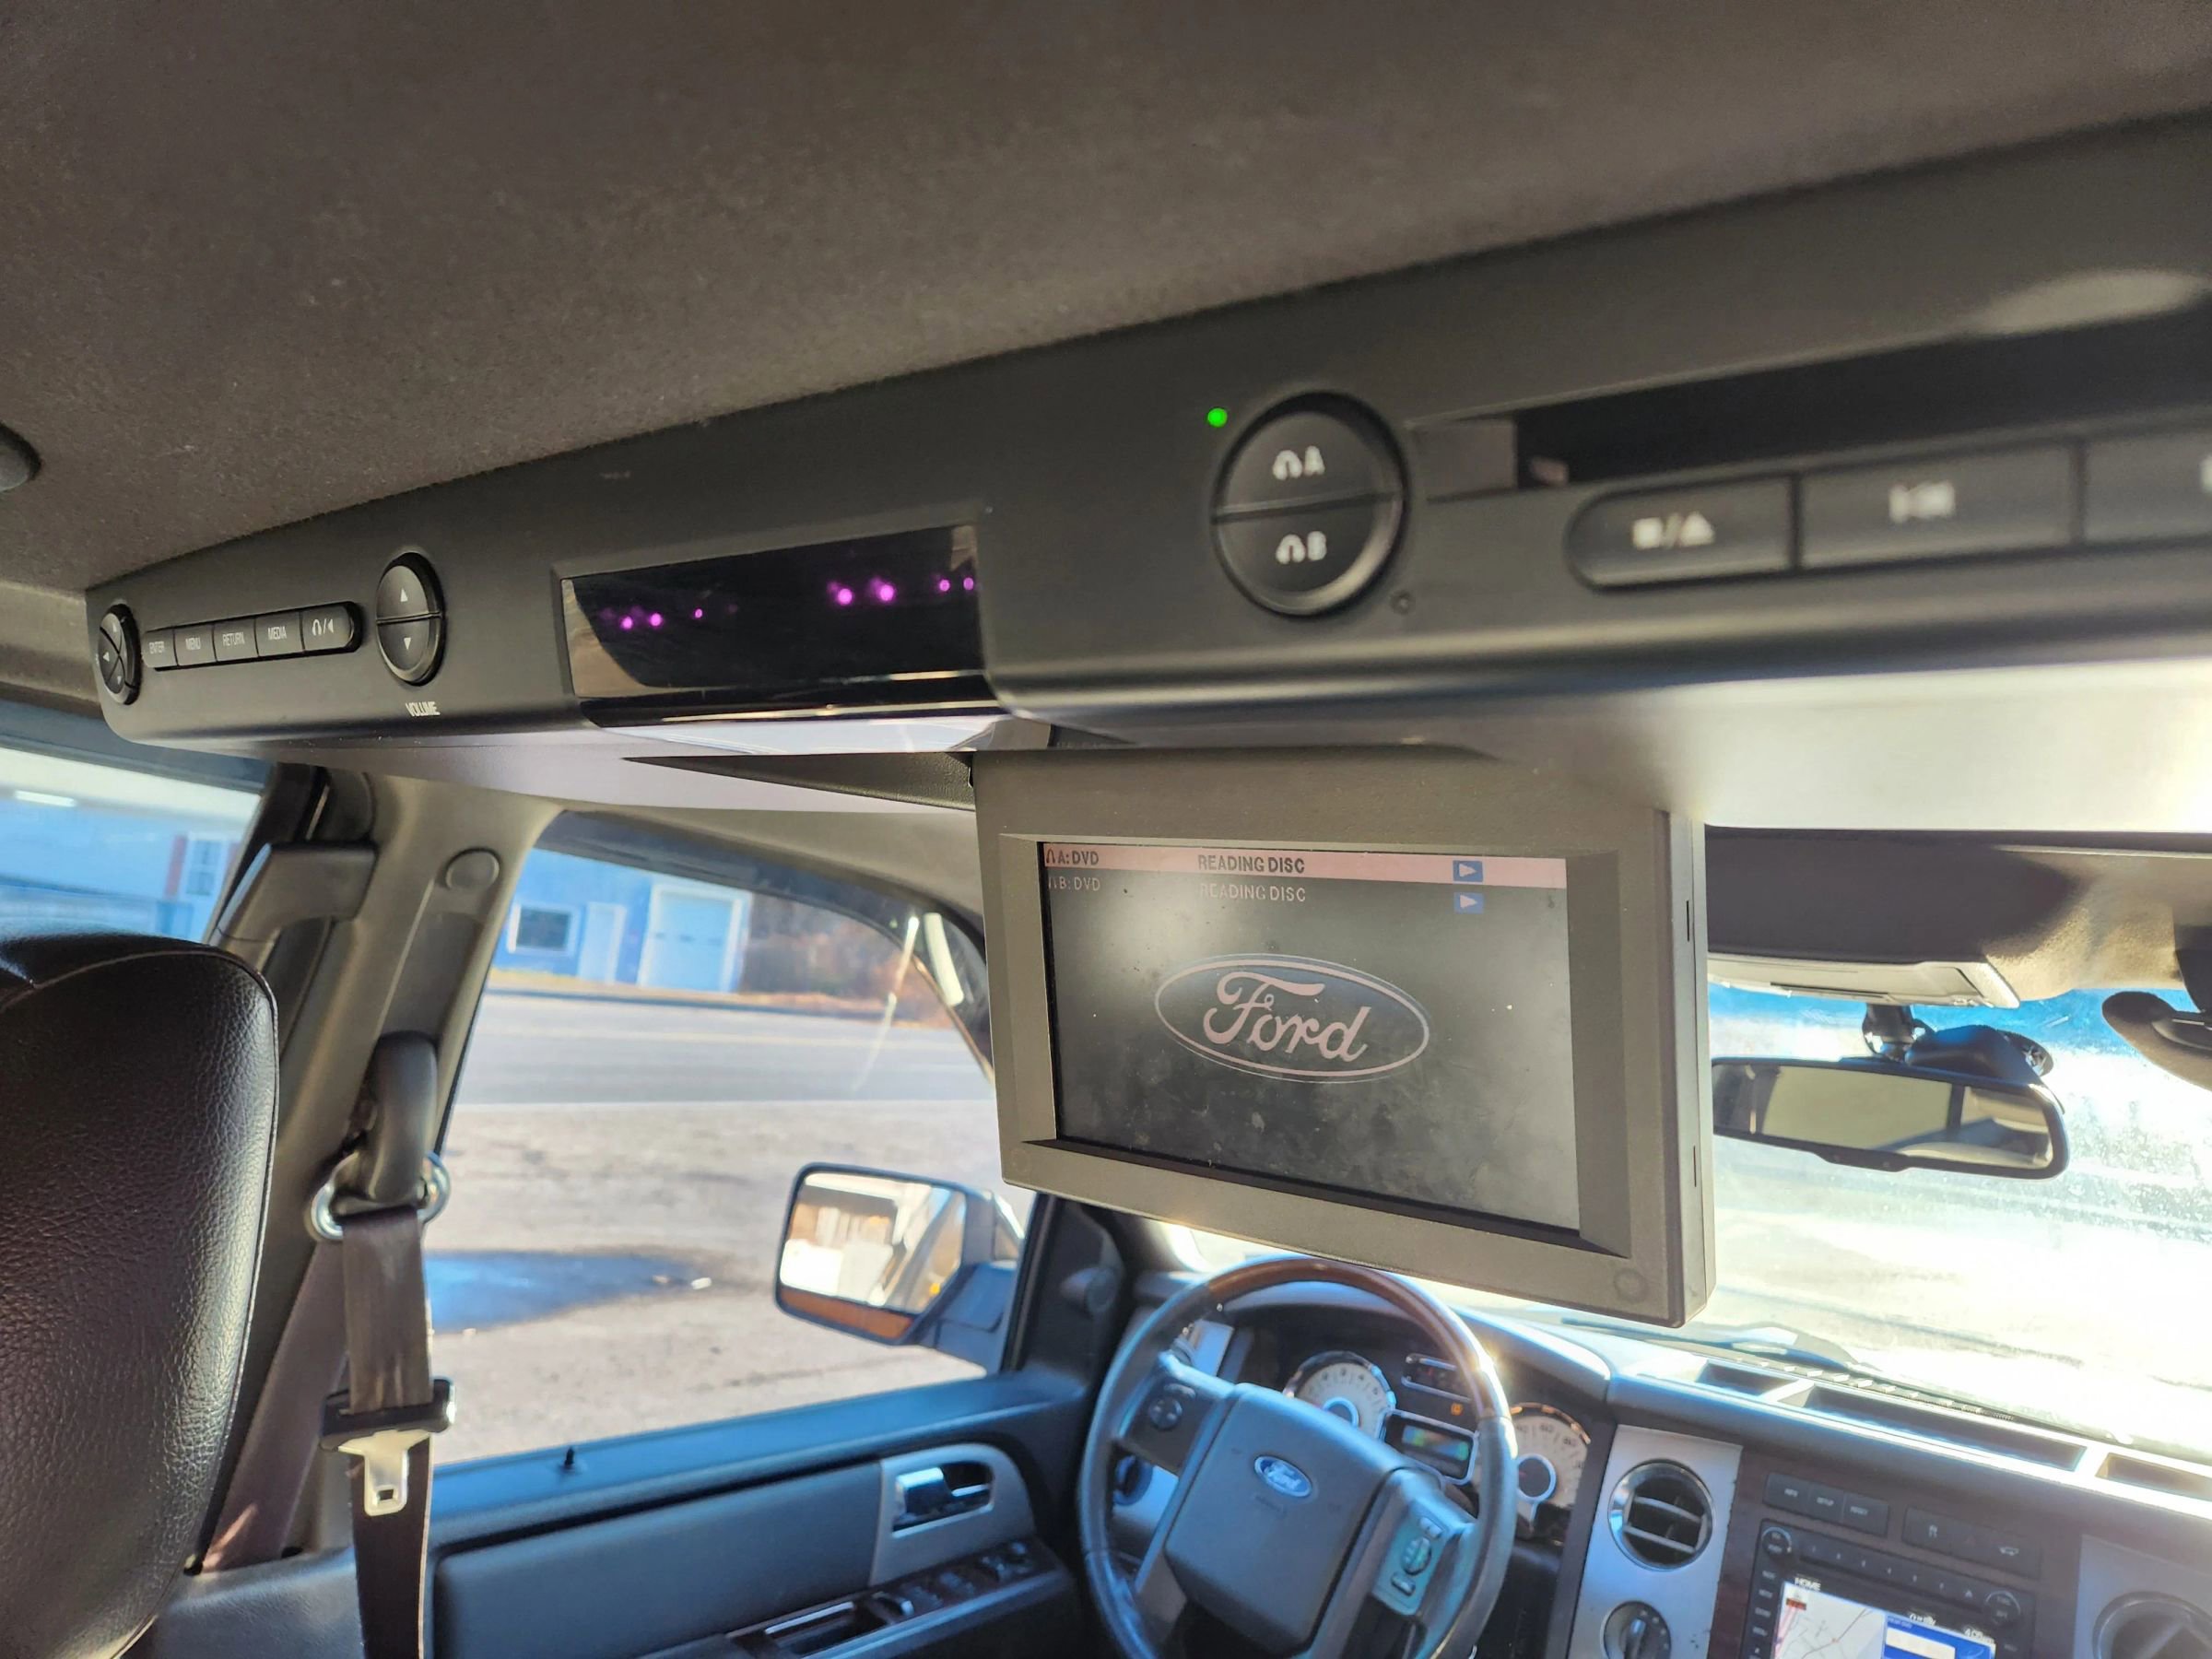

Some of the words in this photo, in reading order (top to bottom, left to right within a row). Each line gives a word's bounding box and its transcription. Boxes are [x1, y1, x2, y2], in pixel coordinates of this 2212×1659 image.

[222, 631, 245, 646] RETURN
[267, 626, 288, 641] MEDIA
[185, 637, 201, 651] MENU
[405, 700, 441, 717] VOLUME
[1198, 853, 1265, 873] READING
[1268, 856, 1306, 874] DISC
[1200, 883, 1266, 900] READING
[1269, 886, 1306, 902] DISC
[1203, 971, 1372, 1063] Ford
